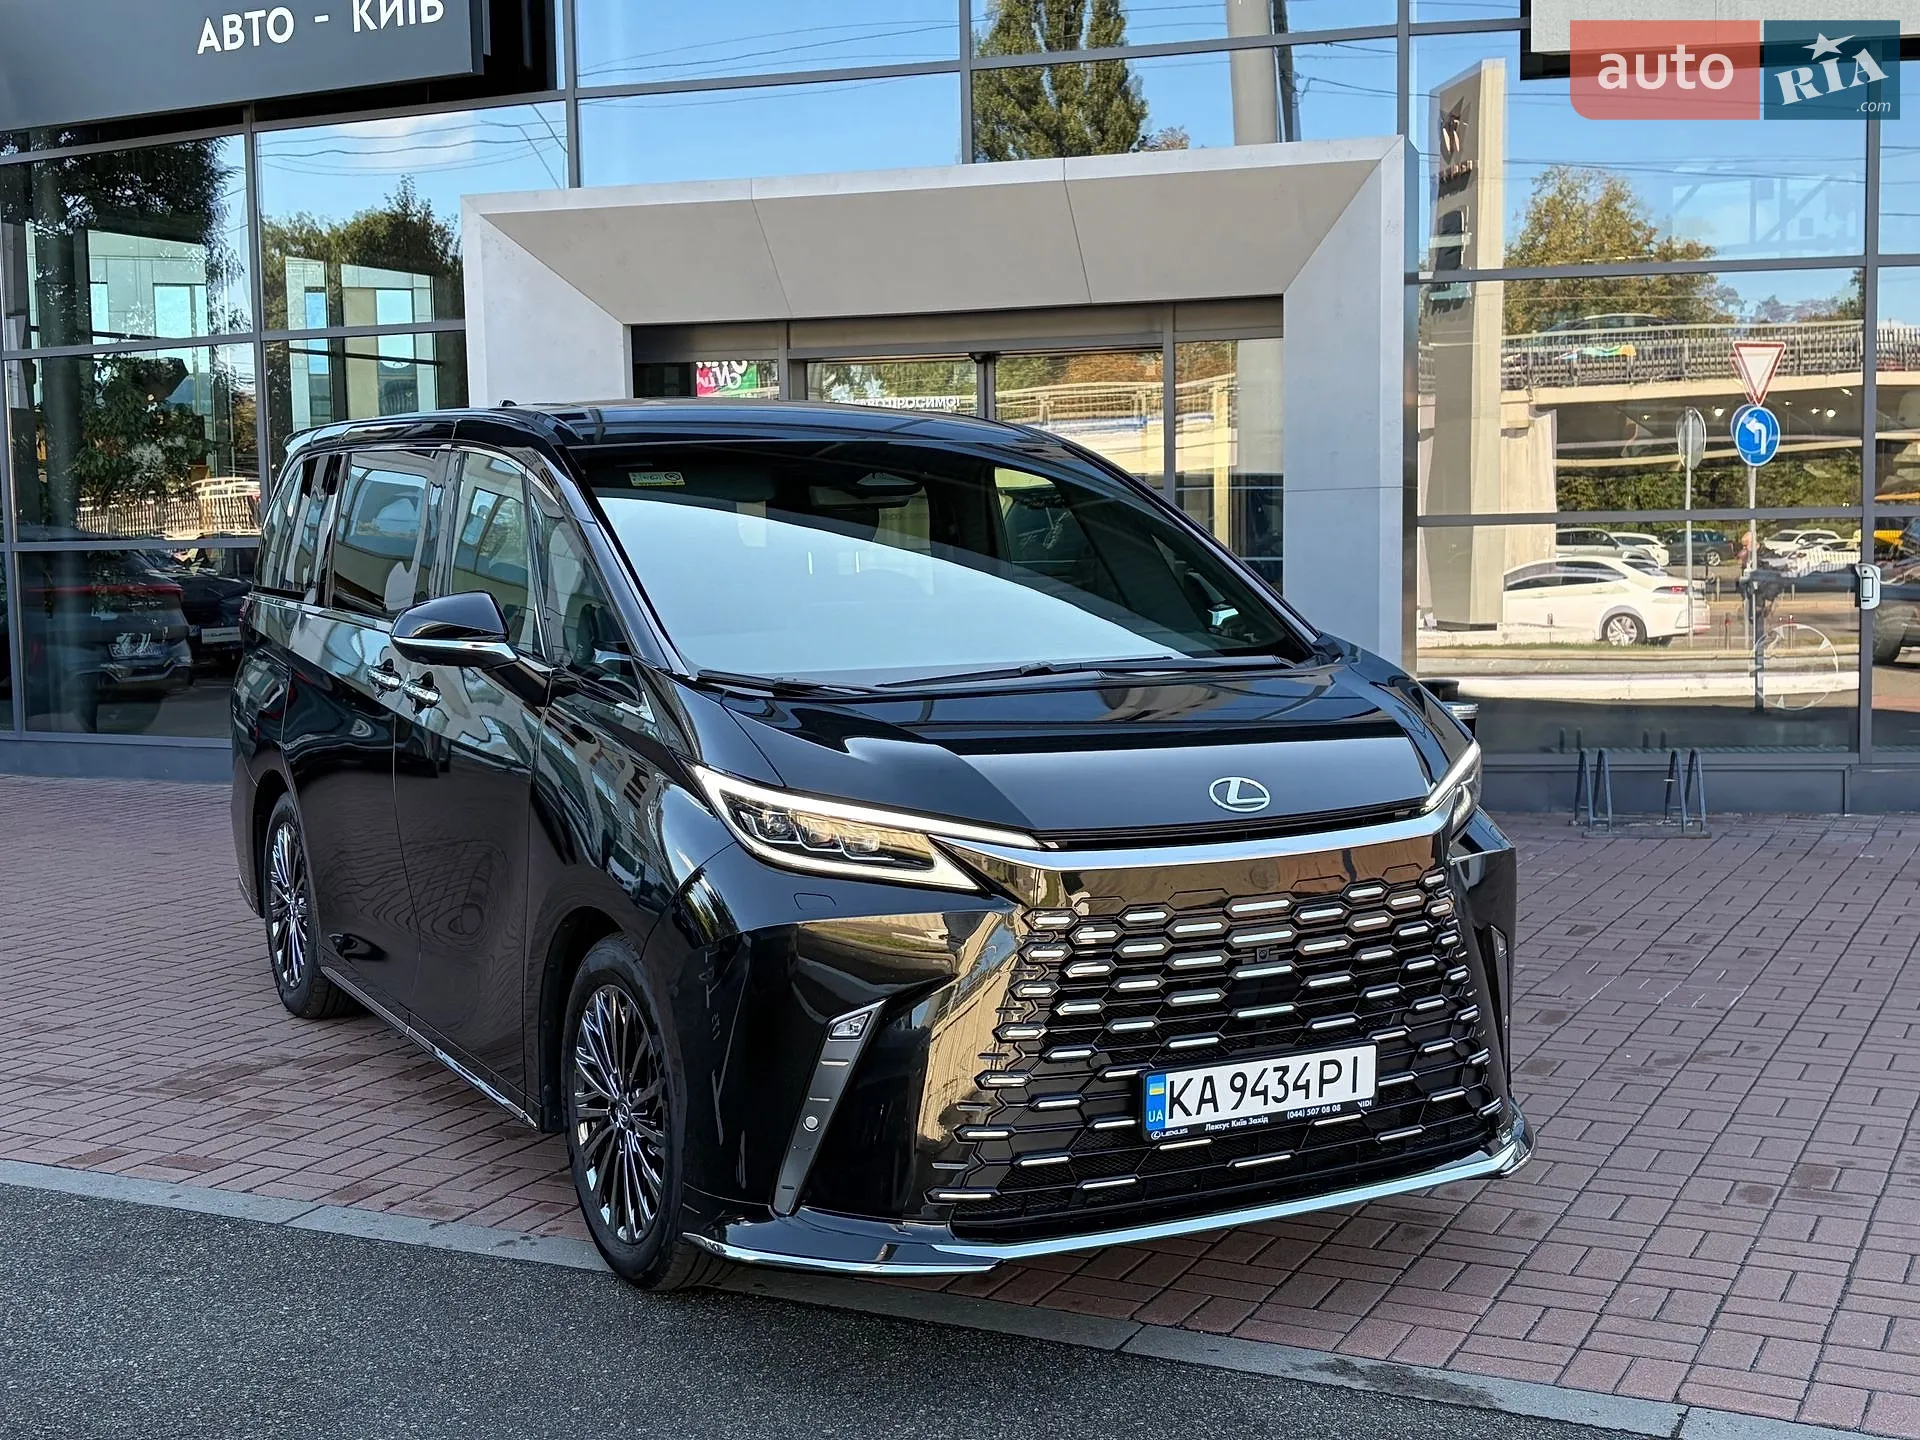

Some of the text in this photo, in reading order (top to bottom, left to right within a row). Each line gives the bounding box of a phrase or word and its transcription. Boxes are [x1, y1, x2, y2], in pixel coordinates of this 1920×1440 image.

[197, 6, 296, 55] АВТО
[1148, 1110, 1164, 1123] UA
[1287, 1104, 1342, 1120] (044) 507 08 08
[1160, 1128, 1189, 1138] LEXUS
[1204, 1121, 1230, 1132] Лексус
